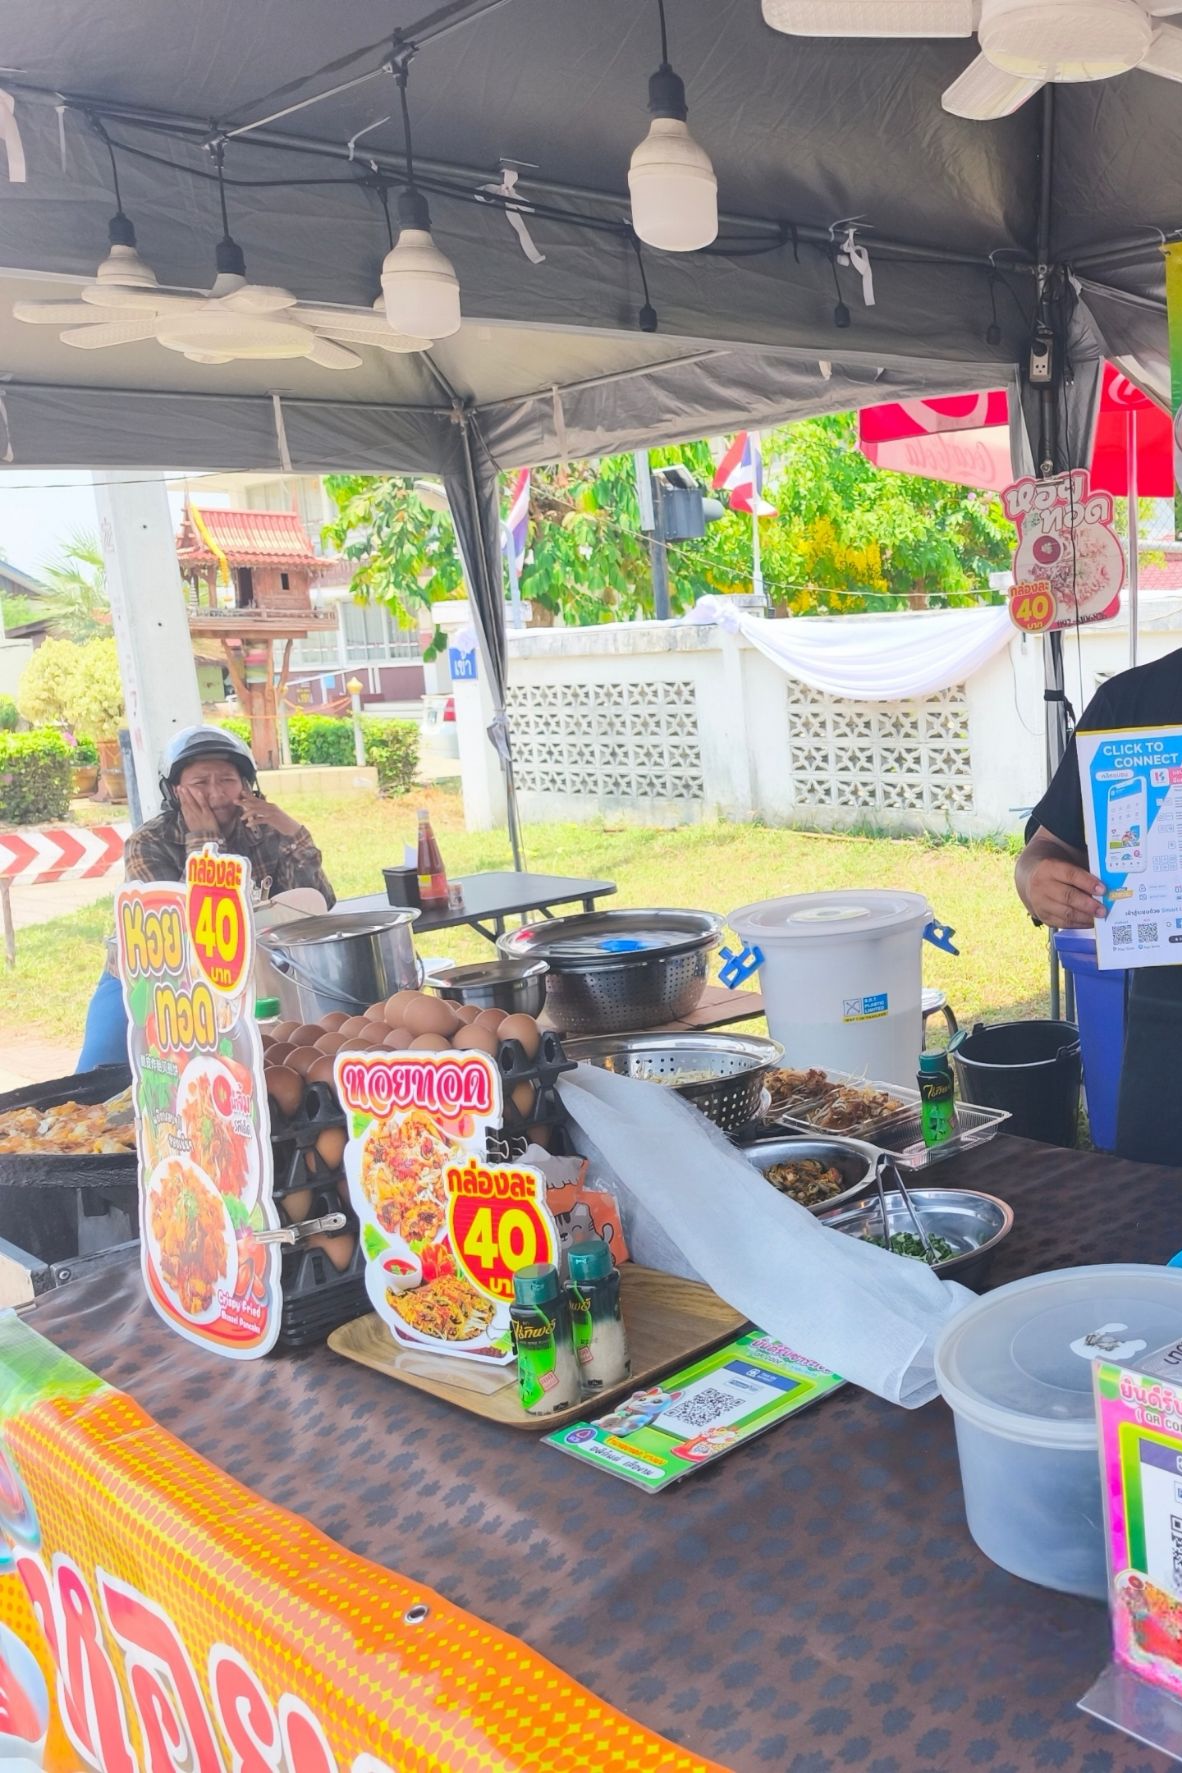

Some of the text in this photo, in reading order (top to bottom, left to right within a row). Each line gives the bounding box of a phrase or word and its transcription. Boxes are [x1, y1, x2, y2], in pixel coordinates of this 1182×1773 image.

[1006, 477, 1083, 515] หอย
[1041, 498, 1108, 533] ทอด
[1016, 595, 1049, 621] 40
[1103, 742, 1164, 756] CLICK TO
[1114, 753, 1179, 768] CONNECT
[188, 848, 242, 886] กล่องละ
[123, 903, 182, 974] หอย
[195, 897, 238, 962] 40
[210, 970, 232, 984] บาท
[156, 984, 216, 1050] ทอด
[345, 1065, 487, 1114] หอยทอด
[447, 1161, 535, 1197] กล่องละ
[463, 1207, 536, 1273] 40
[489, 1276, 515, 1296] บา
